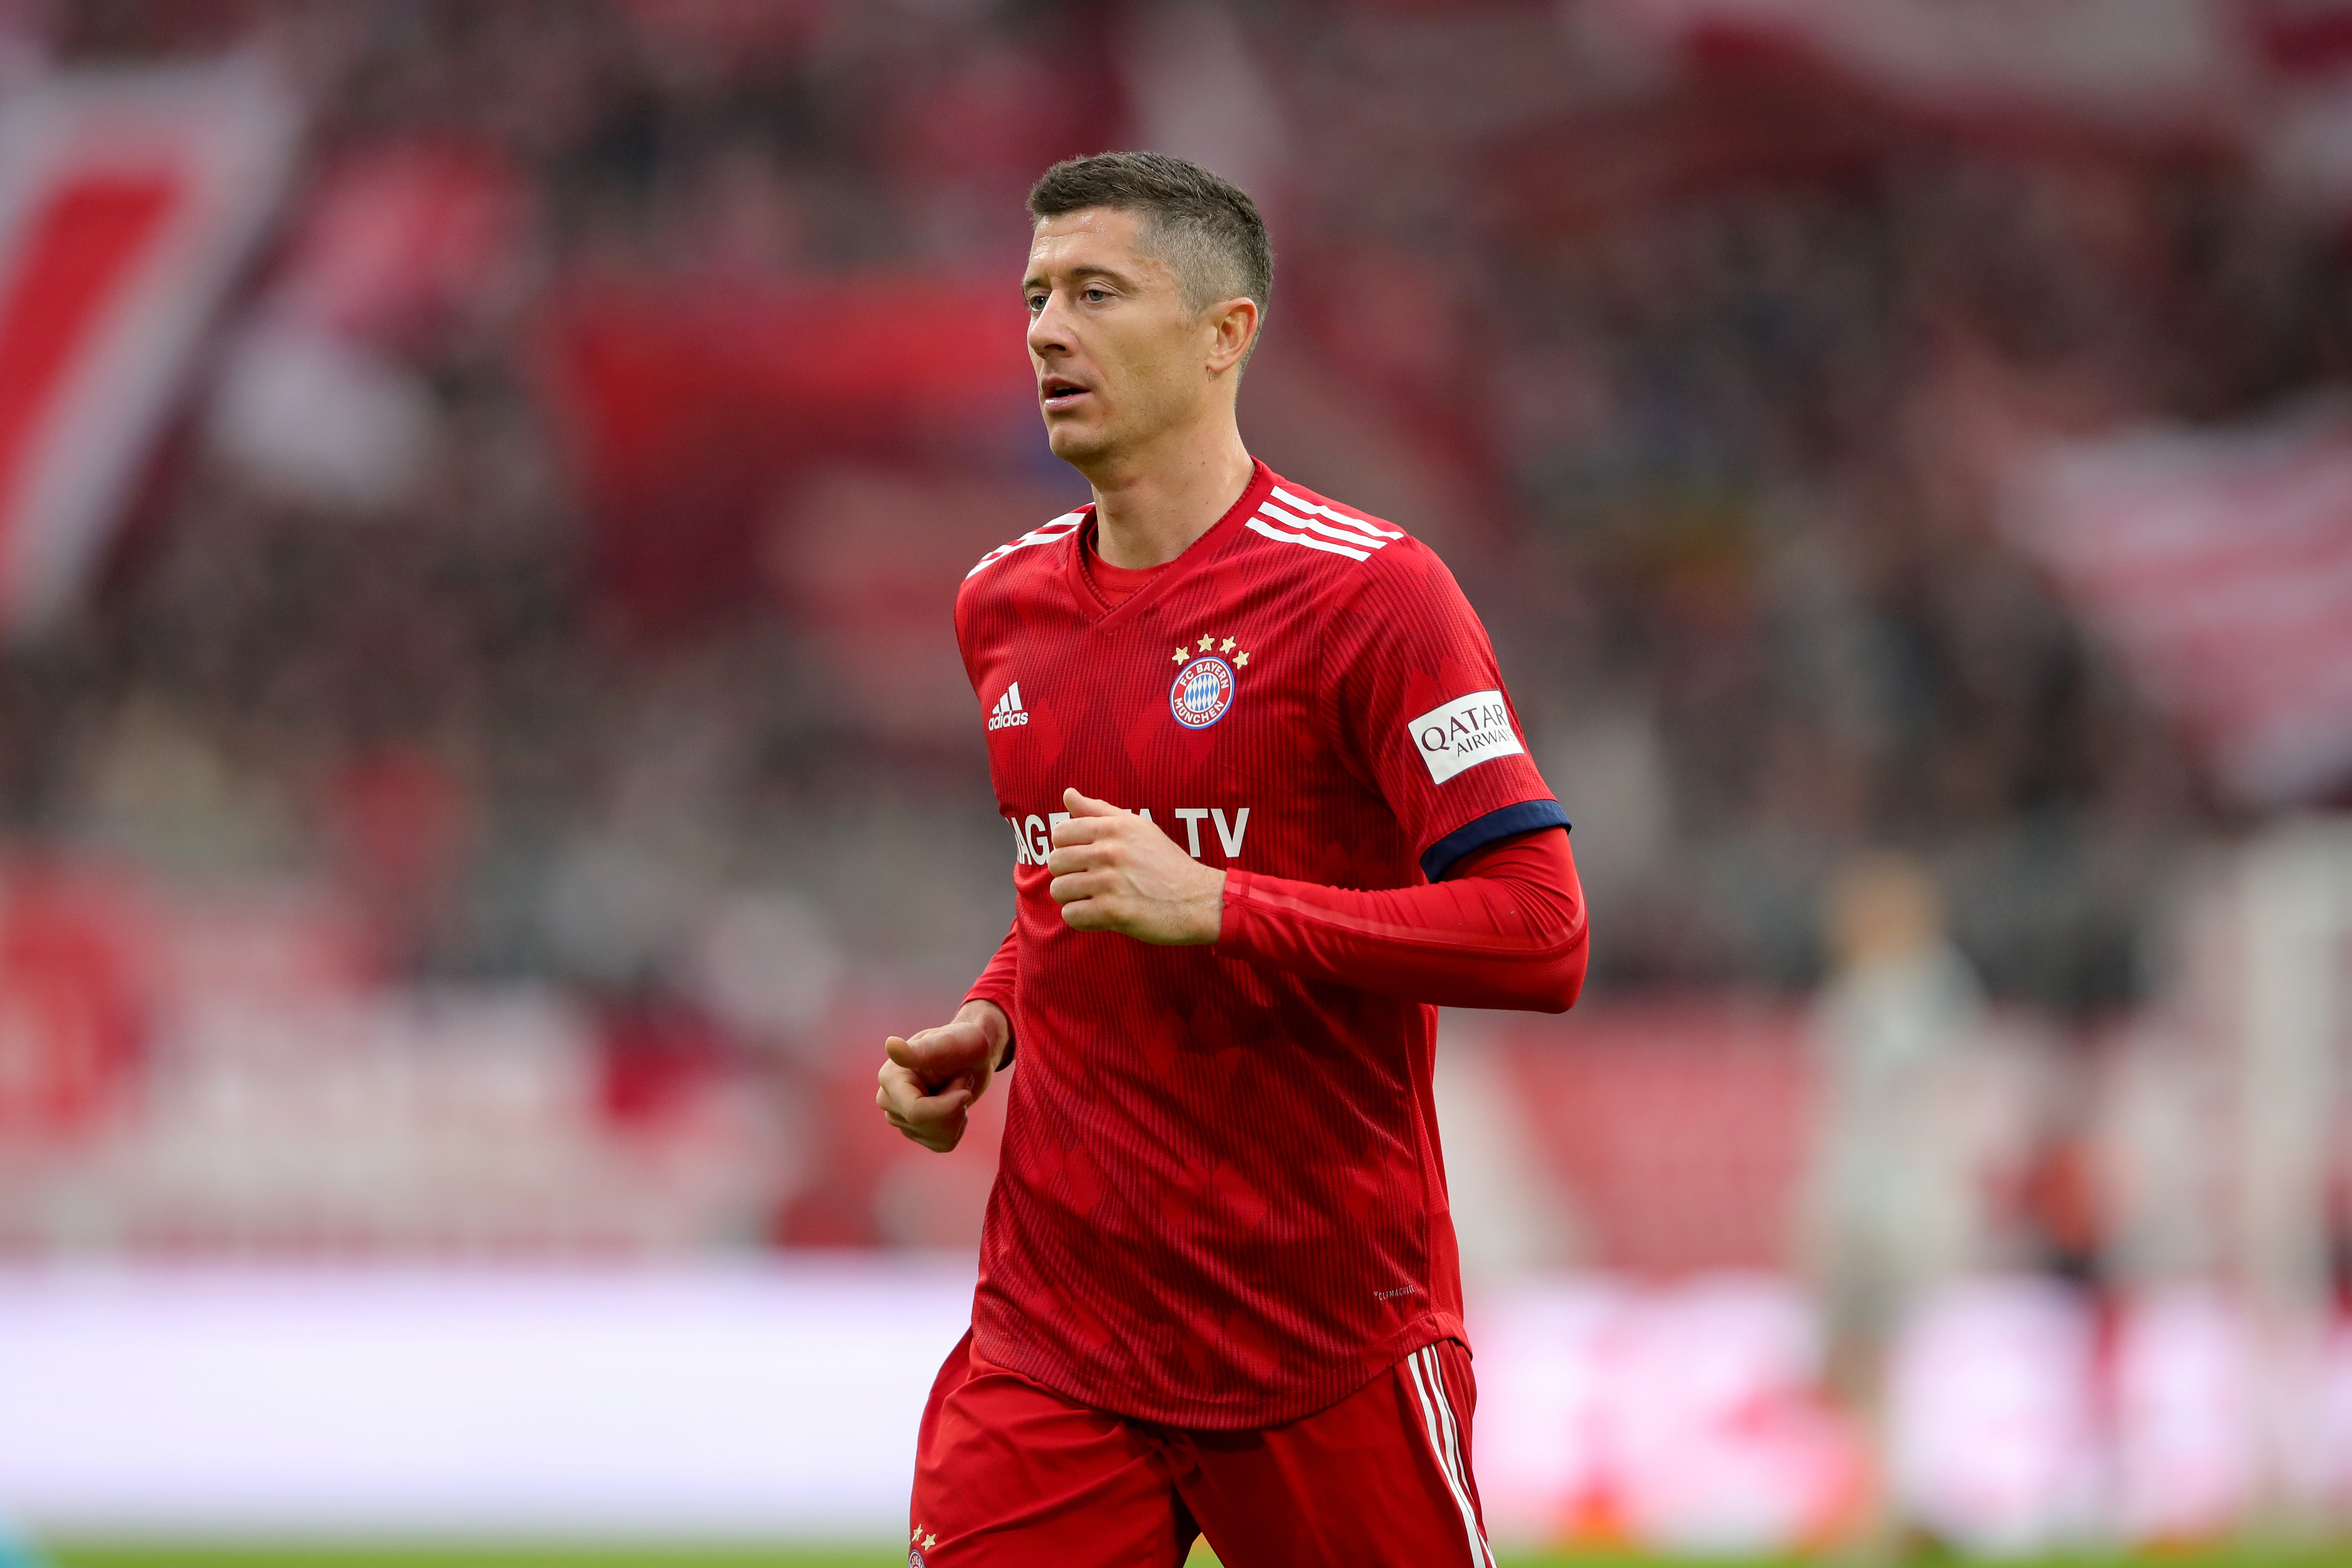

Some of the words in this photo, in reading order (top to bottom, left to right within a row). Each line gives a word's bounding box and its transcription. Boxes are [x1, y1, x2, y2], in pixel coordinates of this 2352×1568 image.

[1179, 671, 1194, 686] FC
[1196, 662, 1229, 689] BAYERN
[988, 710, 1029, 731] adidas
[1174, 697, 1225, 723] MÜNCHEN
[1421, 704, 1508, 752] QATAR
[1458, 729, 1516, 757] AIRWAYS
[1175, 807, 1250, 858] TV
[1378, 1284, 1415, 1301] CLIMACHILL
